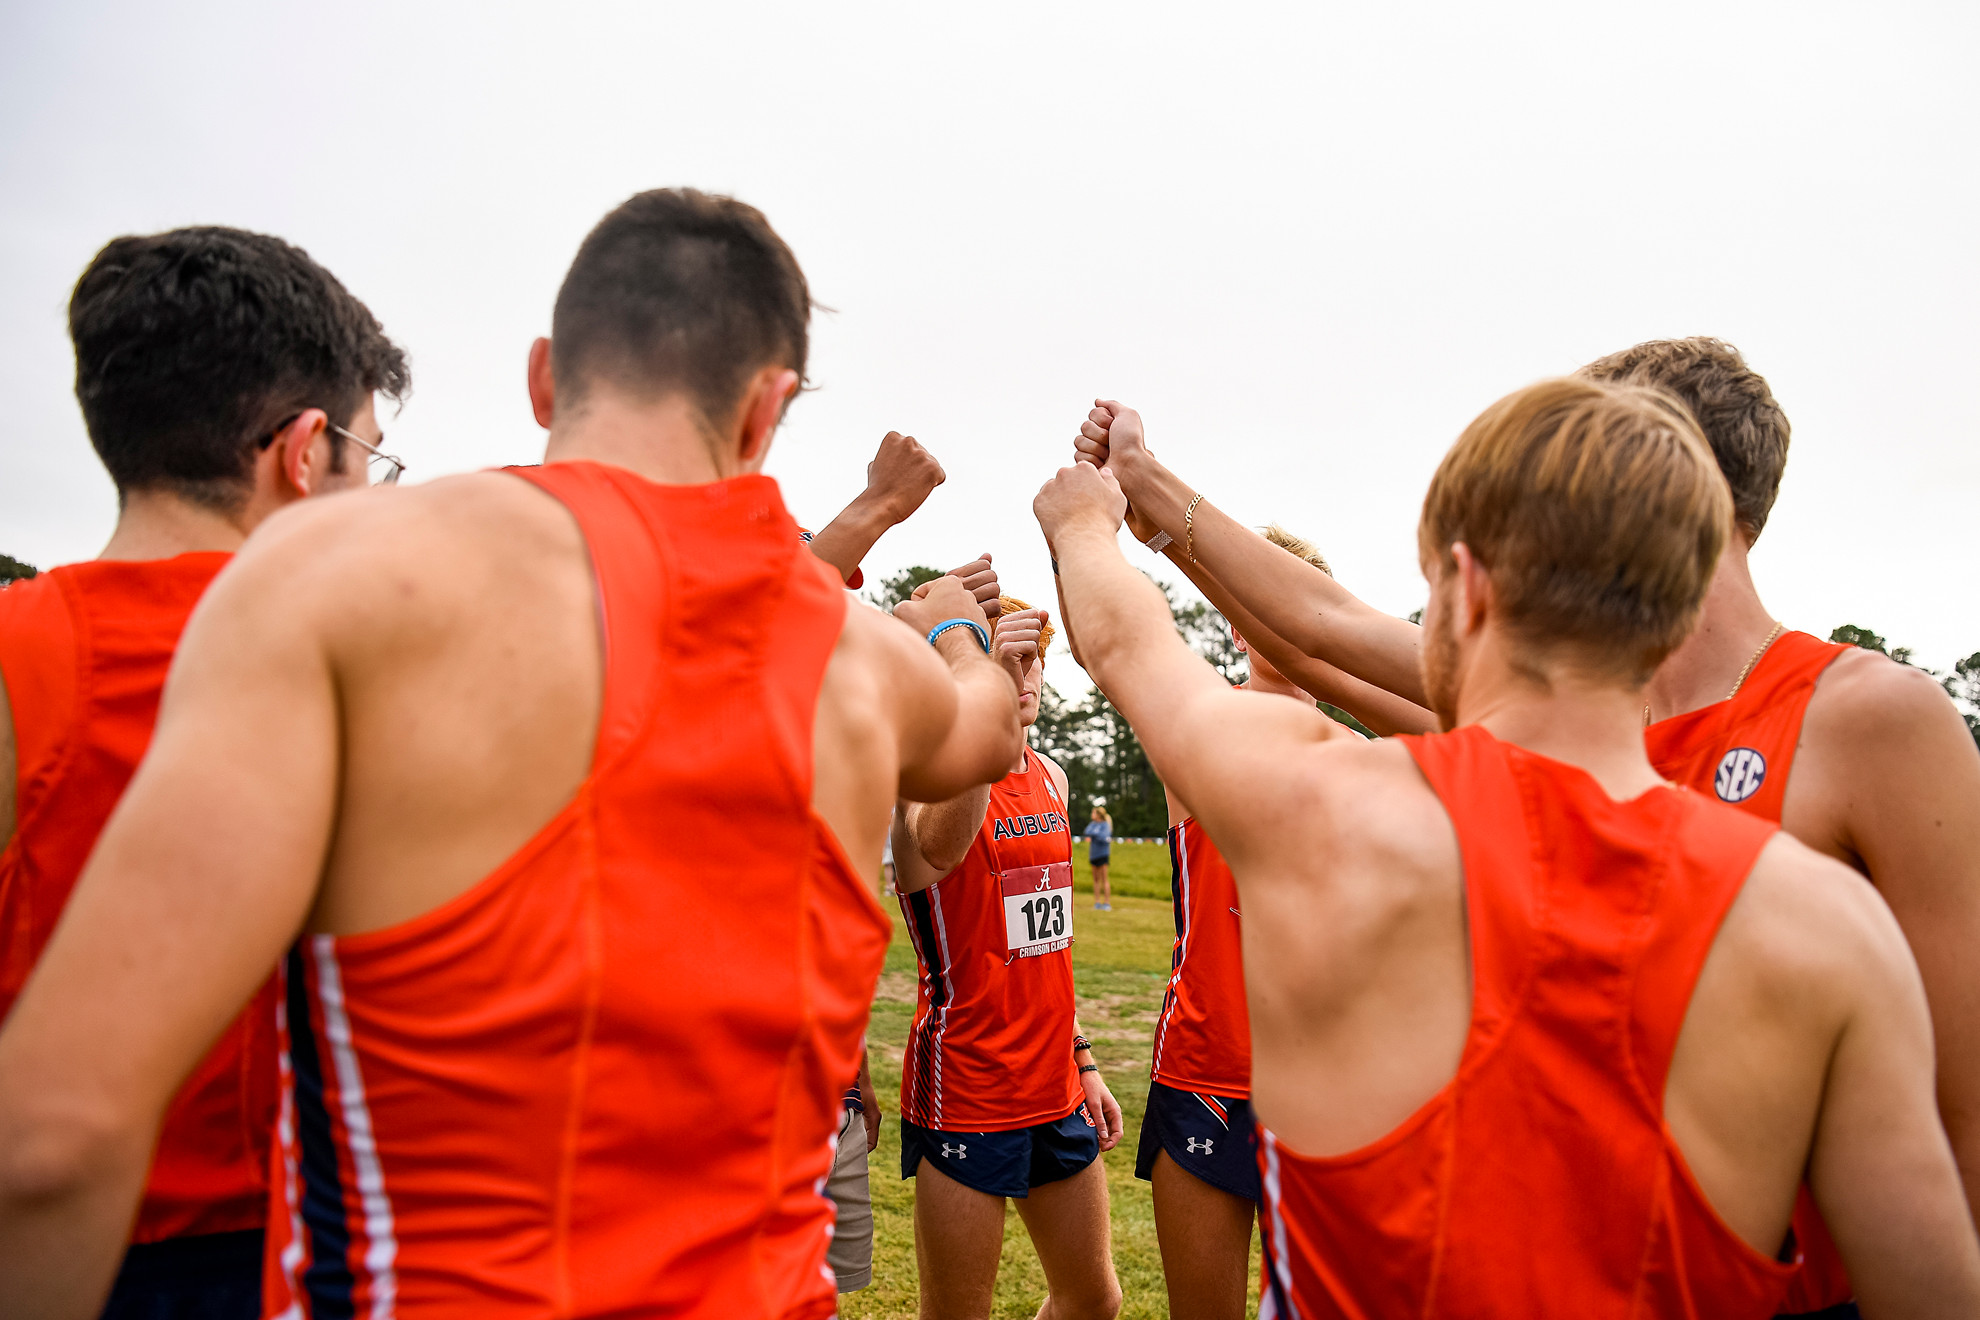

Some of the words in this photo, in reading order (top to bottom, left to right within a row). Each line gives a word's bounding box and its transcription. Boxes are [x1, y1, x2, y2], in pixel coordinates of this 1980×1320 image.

[1715, 748, 1764, 801] SEC
[1035, 866, 1051, 891] A
[1021, 894, 1064, 941] 123
[1019, 943, 1050, 958] CRIMSON
